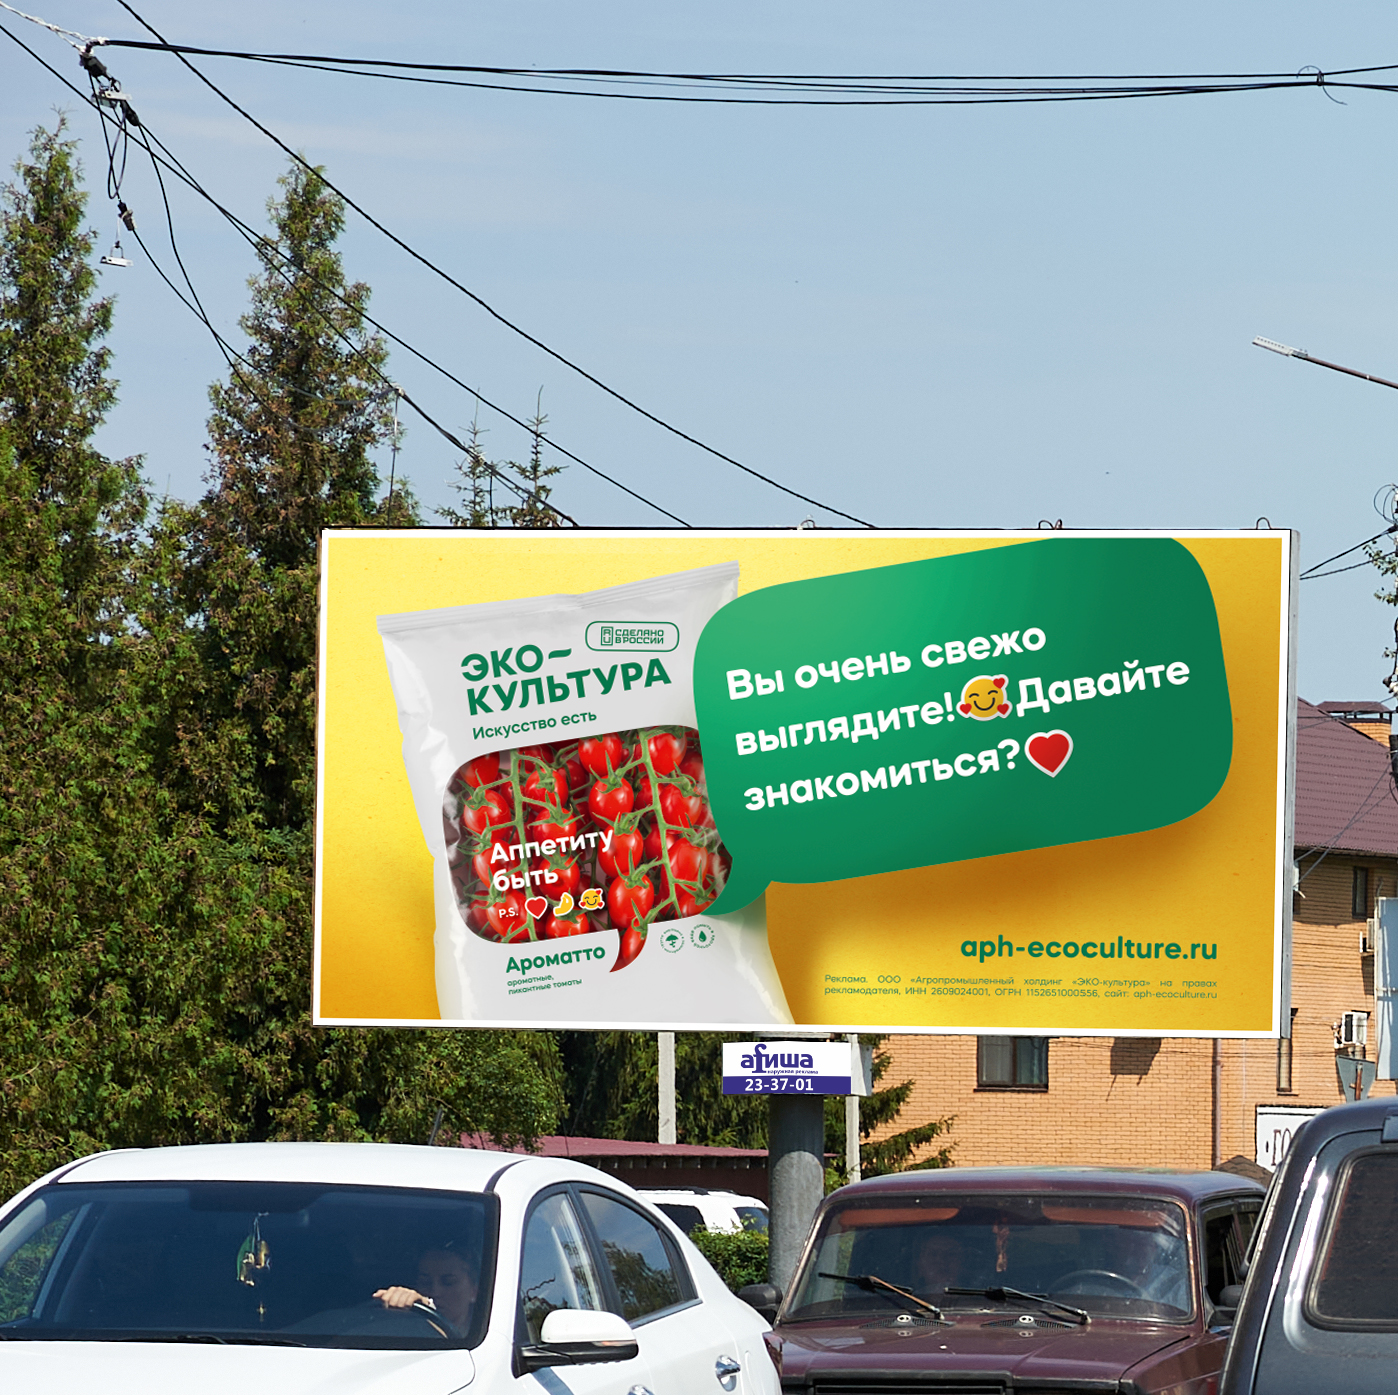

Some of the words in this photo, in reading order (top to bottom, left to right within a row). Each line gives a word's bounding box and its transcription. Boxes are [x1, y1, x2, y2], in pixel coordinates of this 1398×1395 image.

[614, 628, 665, 637] СДЕЛАНО
[726, 666, 785, 701] Вы
[794, 651, 912, 689] очень
[921, 627, 1047, 669] свежо
[466, 658, 672, 716] КУЛЬТУРА
[735, 692, 956, 756] выглядите!
[1015, 659, 1190, 718] Давайте
[473, 718, 557, 740] Искусство
[560, 711, 598, 726] есть
[743, 738, 1021, 812] знакомиться?
[490, 829, 614, 864] Аппетиту
[492, 867, 559, 892] быть
[498, 907, 519, 919] P.S.
[506, 946, 606, 975] Ароматто
[960, 934, 1218, 963] aph-ecoculture.ru
[508, 983, 551, 995] пикантные
[553, 978, 583, 988] томаты
[824, 974, 868, 984] Реклама.
[877, 975, 901, 984] ООО
[1023, 977, 1063, 987] холдинг
[1160, 979, 1173, 987] на
[1182, 979, 1218, 988] правах
[824, 986, 901, 996] рекламодателя,
[905, 987, 927, 995] ИНН
[994, 988, 1022, 996] ОГРН
[1104, 988, 1130, 998] сайт:
[1133, 989, 1218, 999] aph-ecoculture.ru
[744, 1078, 814, 1092] 23-37-01
